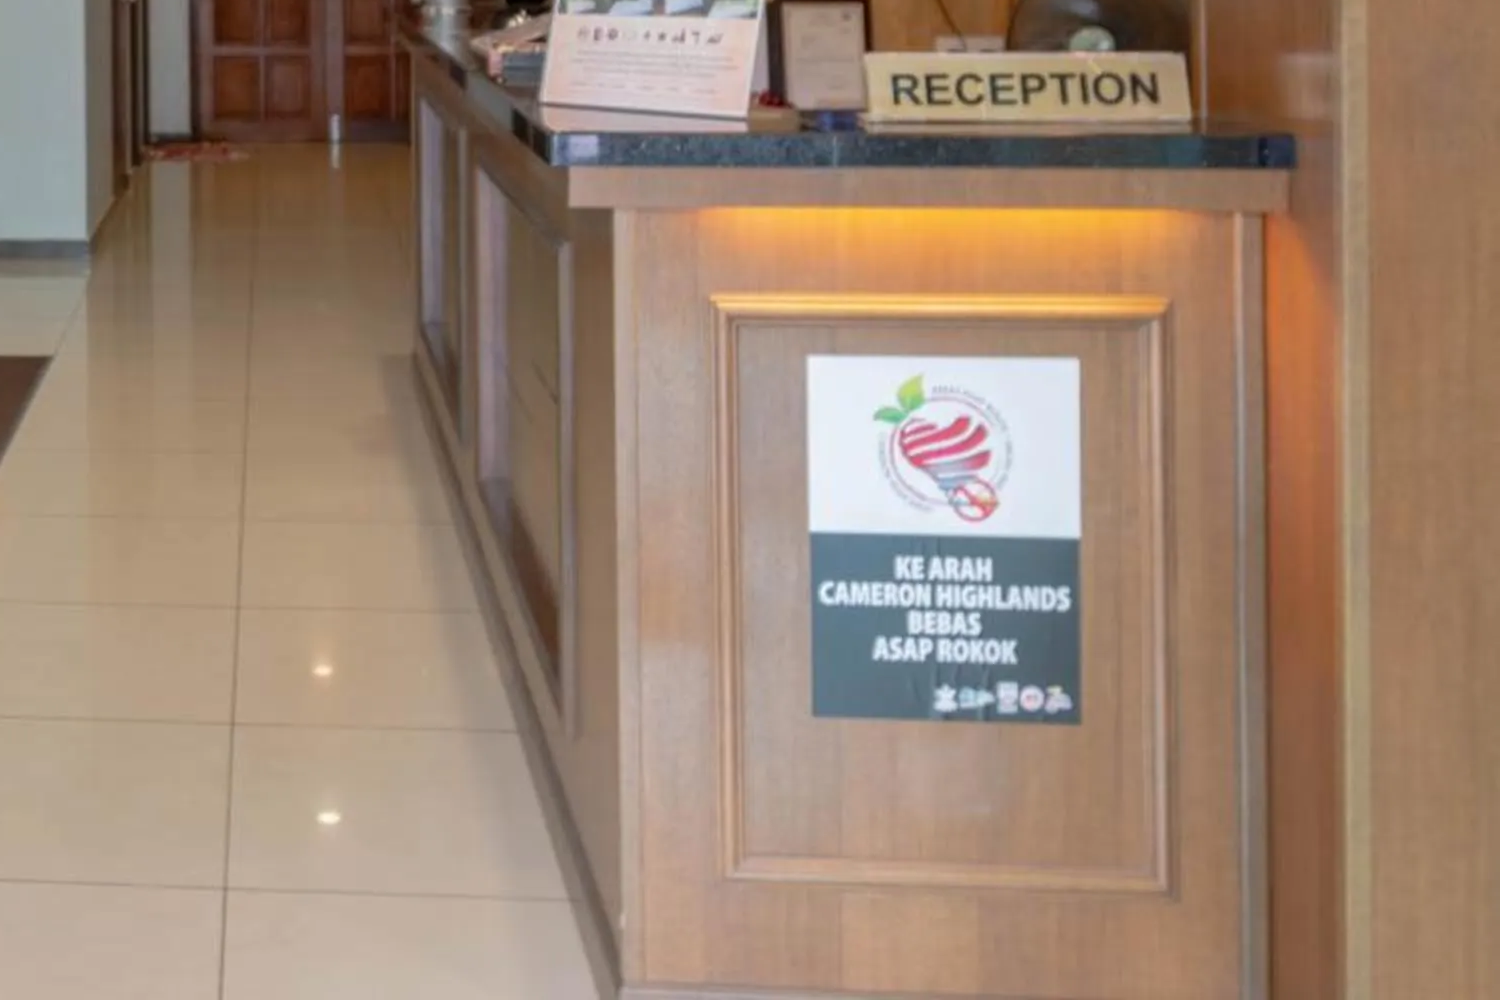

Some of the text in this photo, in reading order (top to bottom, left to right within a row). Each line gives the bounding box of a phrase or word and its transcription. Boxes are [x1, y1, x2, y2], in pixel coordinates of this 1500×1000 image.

[891, 72, 1161, 106] RECEPTION
[894, 556, 993, 582] KE ARAH
[818, 581, 1072, 612] CAMERON HIGHLANDS
[907, 610, 982, 637] BEBAS
[872, 636, 1018, 665] ASAP ROKOK
